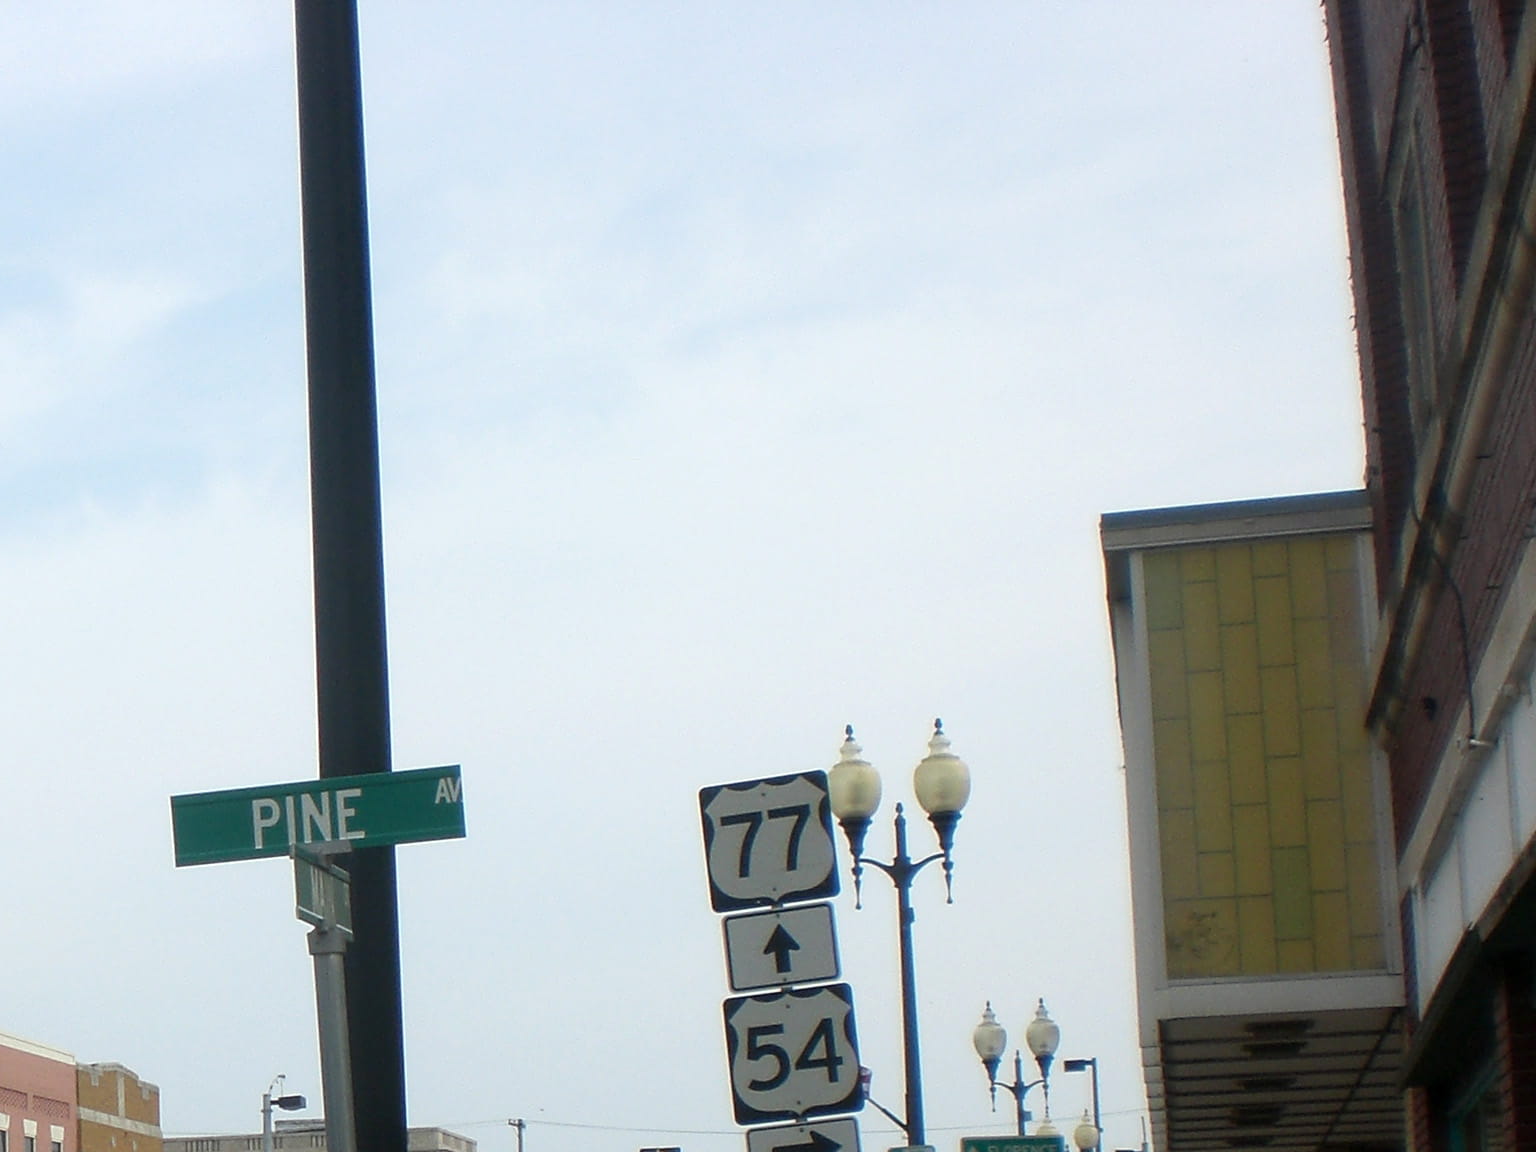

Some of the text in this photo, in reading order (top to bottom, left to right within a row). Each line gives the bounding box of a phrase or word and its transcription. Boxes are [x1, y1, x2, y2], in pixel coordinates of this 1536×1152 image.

[252, 776, 462, 850] PINE AV
[720, 802, 812, 880] 77
[745, 1016, 845, 1093] 54
